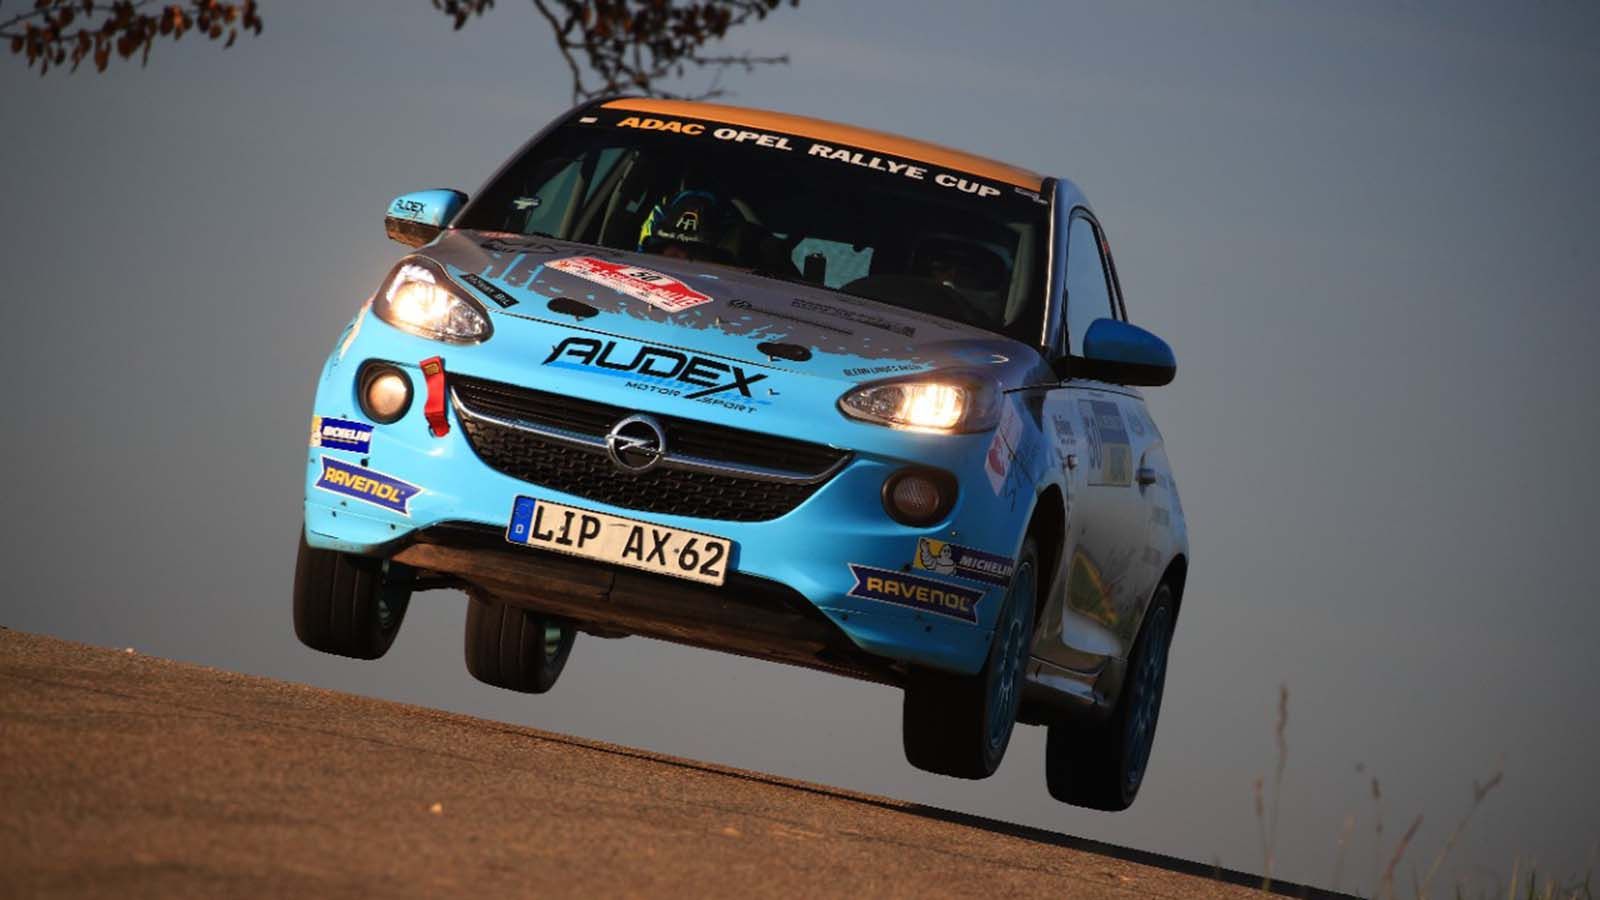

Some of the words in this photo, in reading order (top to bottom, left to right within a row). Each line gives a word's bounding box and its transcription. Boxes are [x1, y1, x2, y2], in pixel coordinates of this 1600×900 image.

[616, 117, 705, 136] ADAC
[713, 128, 793, 151] OPEL
[808, 143, 928, 180] RALLYE
[935, 173, 1001, 198] CUP
[630, 270, 663, 282] 50
[541, 336, 768, 399] AUDEX
[625, 380, 681, 397] MOTOR
[697, 396, 758, 414] SPORT
[324, 466, 402, 502] RAVENOL
[531, 505, 602, 548] LIP
[959, 555, 1014, 577] MICHELIN
[866, 576, 970, 612] RAVENOL
